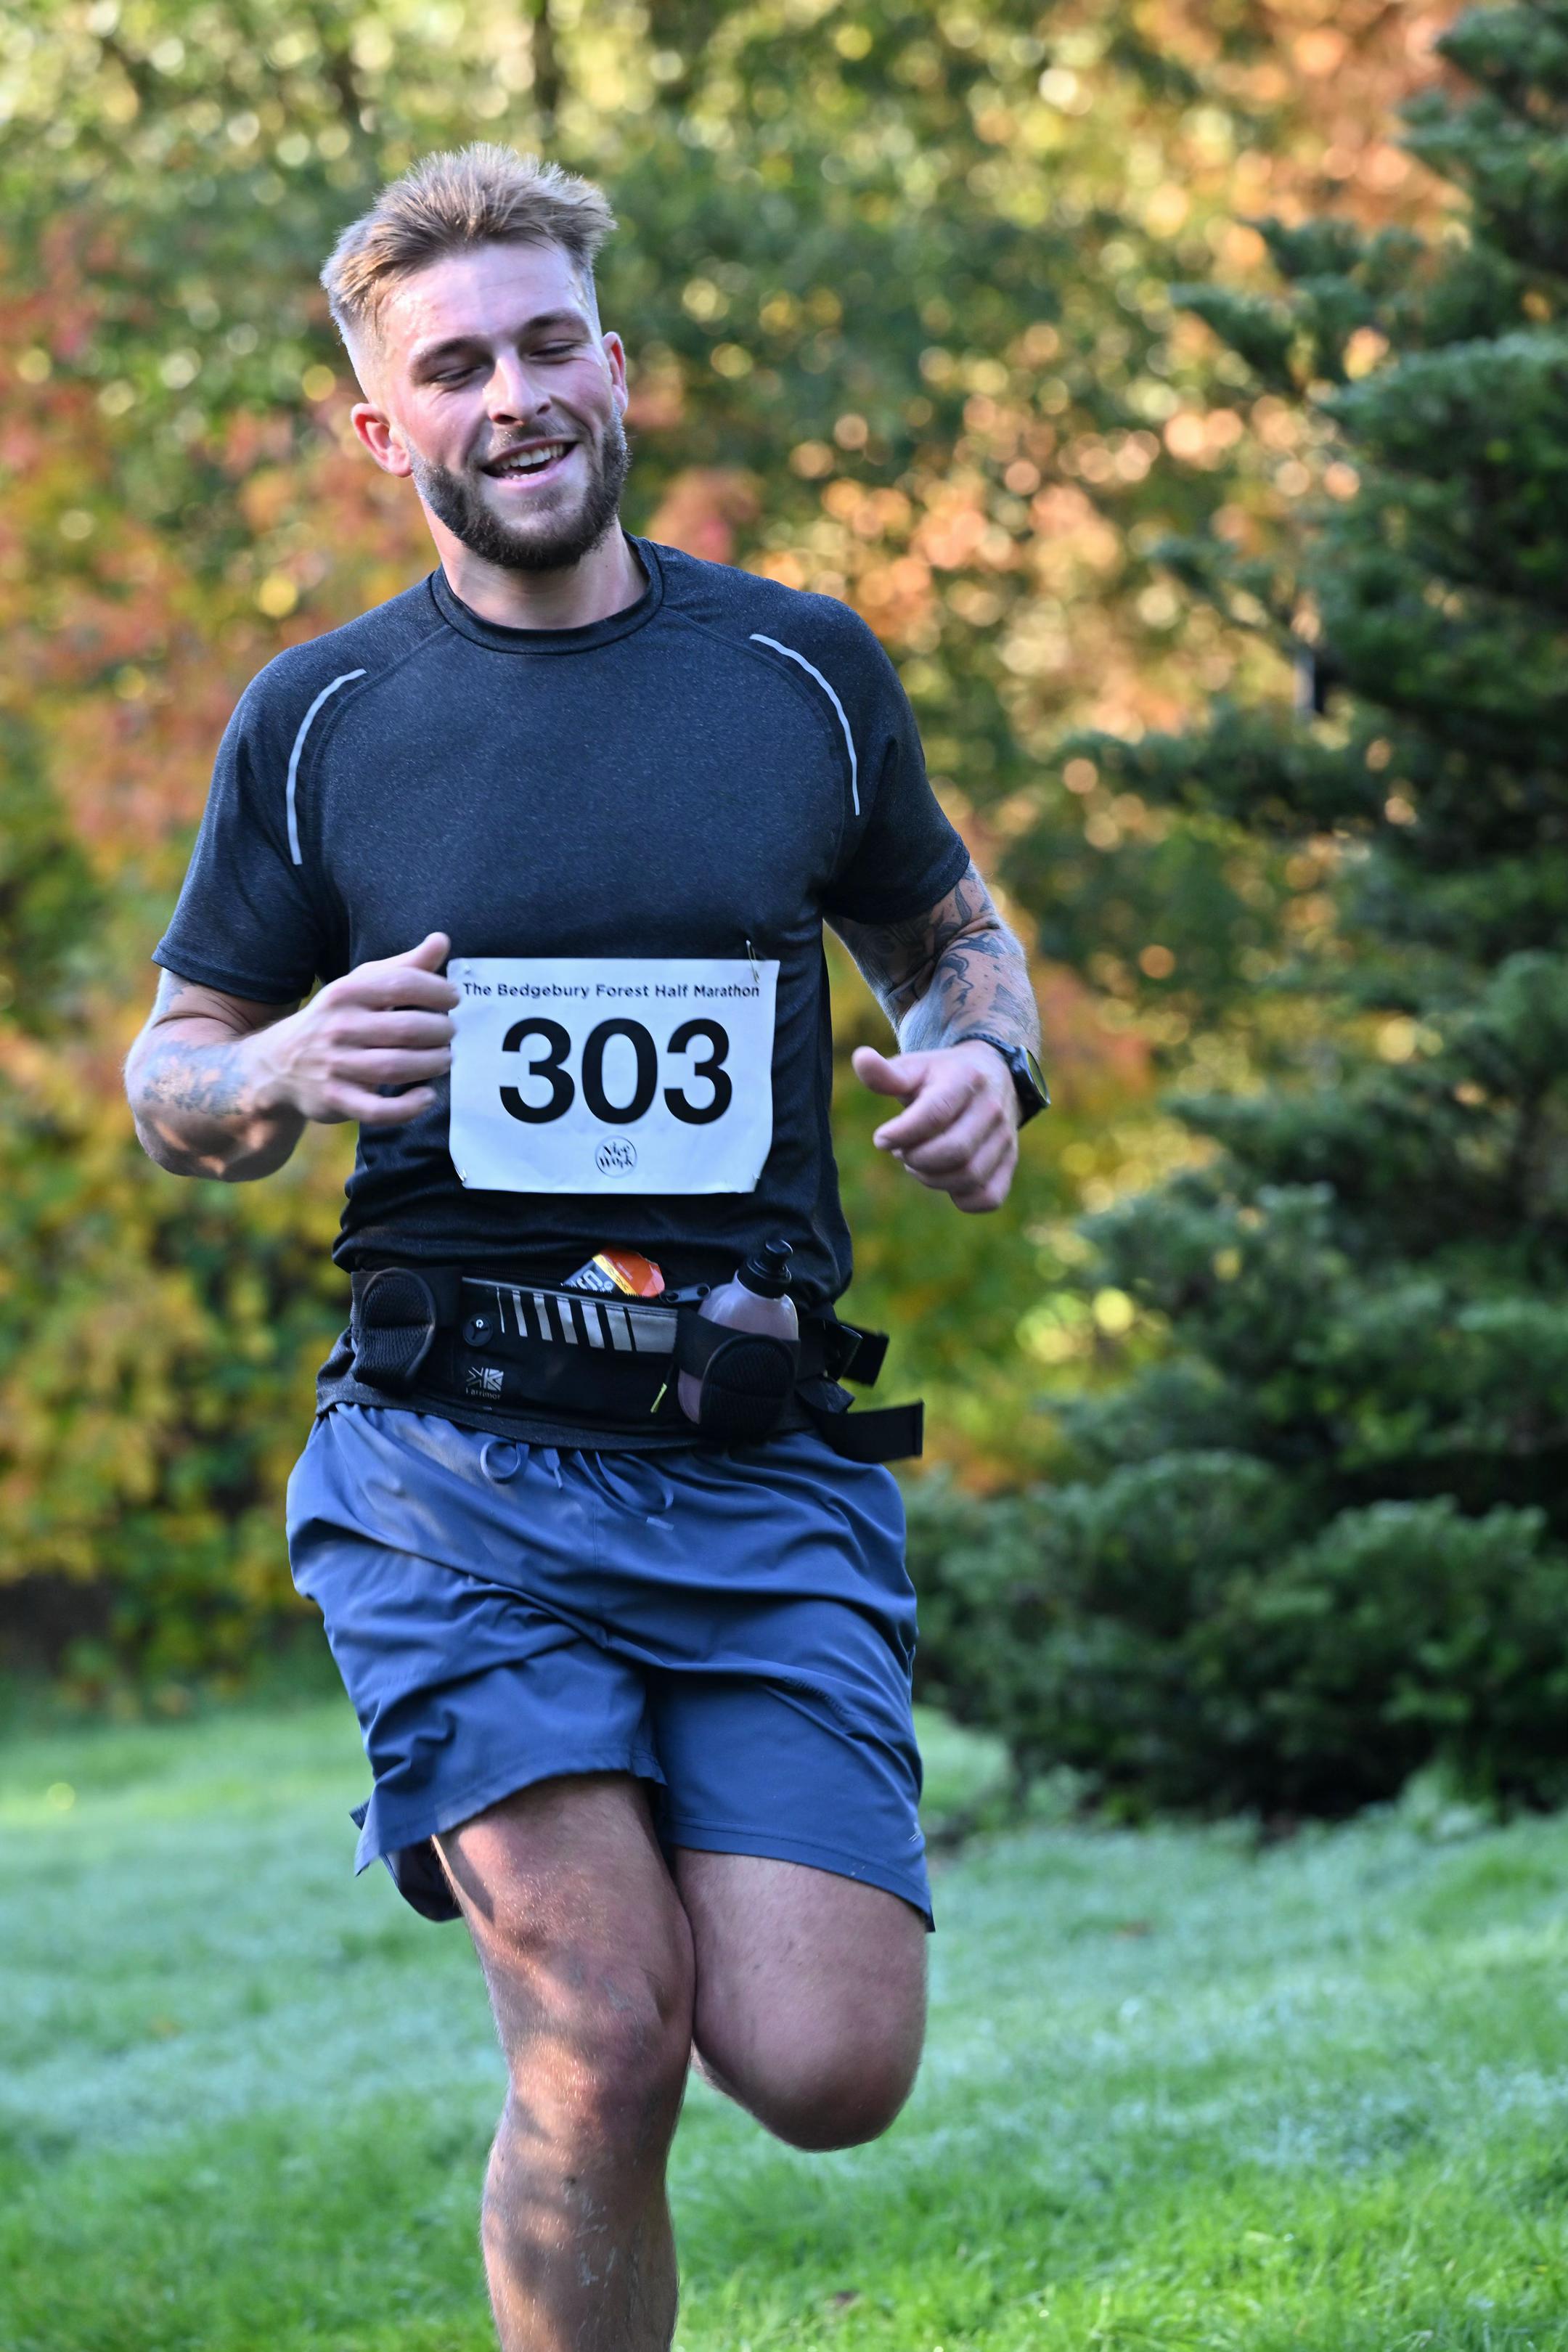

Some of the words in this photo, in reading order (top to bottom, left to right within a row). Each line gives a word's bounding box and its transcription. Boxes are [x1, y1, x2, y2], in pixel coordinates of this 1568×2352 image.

[463, 982, 491, 996] The
[498, 983, 589, 999] Bedgebury
[596, 984, 648, 997] Forest
[655, 984, 688, 997] Half
[694, 984, 759, 997] Marathon
[499, 1017, 732, 1125] 303
